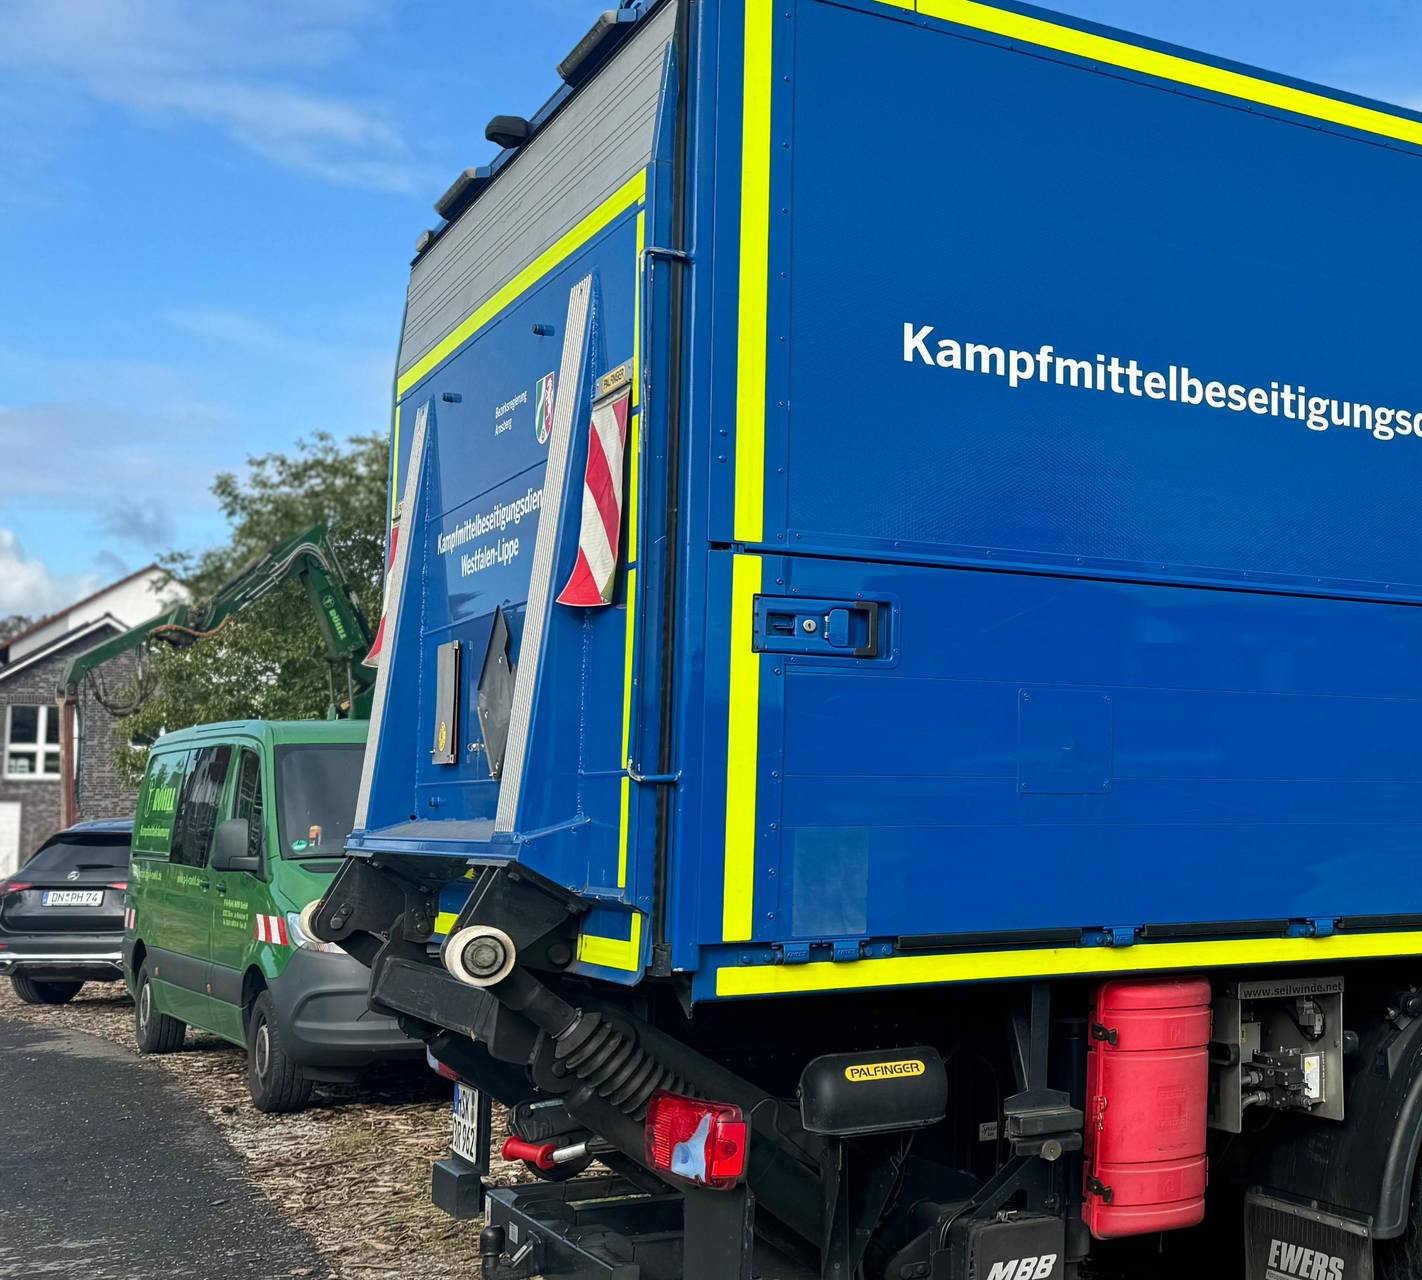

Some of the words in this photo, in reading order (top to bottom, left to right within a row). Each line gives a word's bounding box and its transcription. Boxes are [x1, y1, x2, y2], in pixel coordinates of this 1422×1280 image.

[494, 390, 528, 420] Bezirksregierung
[494, 417, 513, 437] Arnsberg
[437, 487, 544, 556] Kampfmittelbeseitigungsdien
[461, 537, 520, 577] Westfalen-Lippe
[51, 892, 65, 903] DN
[70, 892, 84, 903] PH
[86, 892, 98, 903] 74
[850, 1062, 921, 1079] PALFINGER
[462, 1123, 475, 1158] 962
[986, 1253, 1058, 1280] MBB
[1267, 1238, 1345, 1280] EWERS
